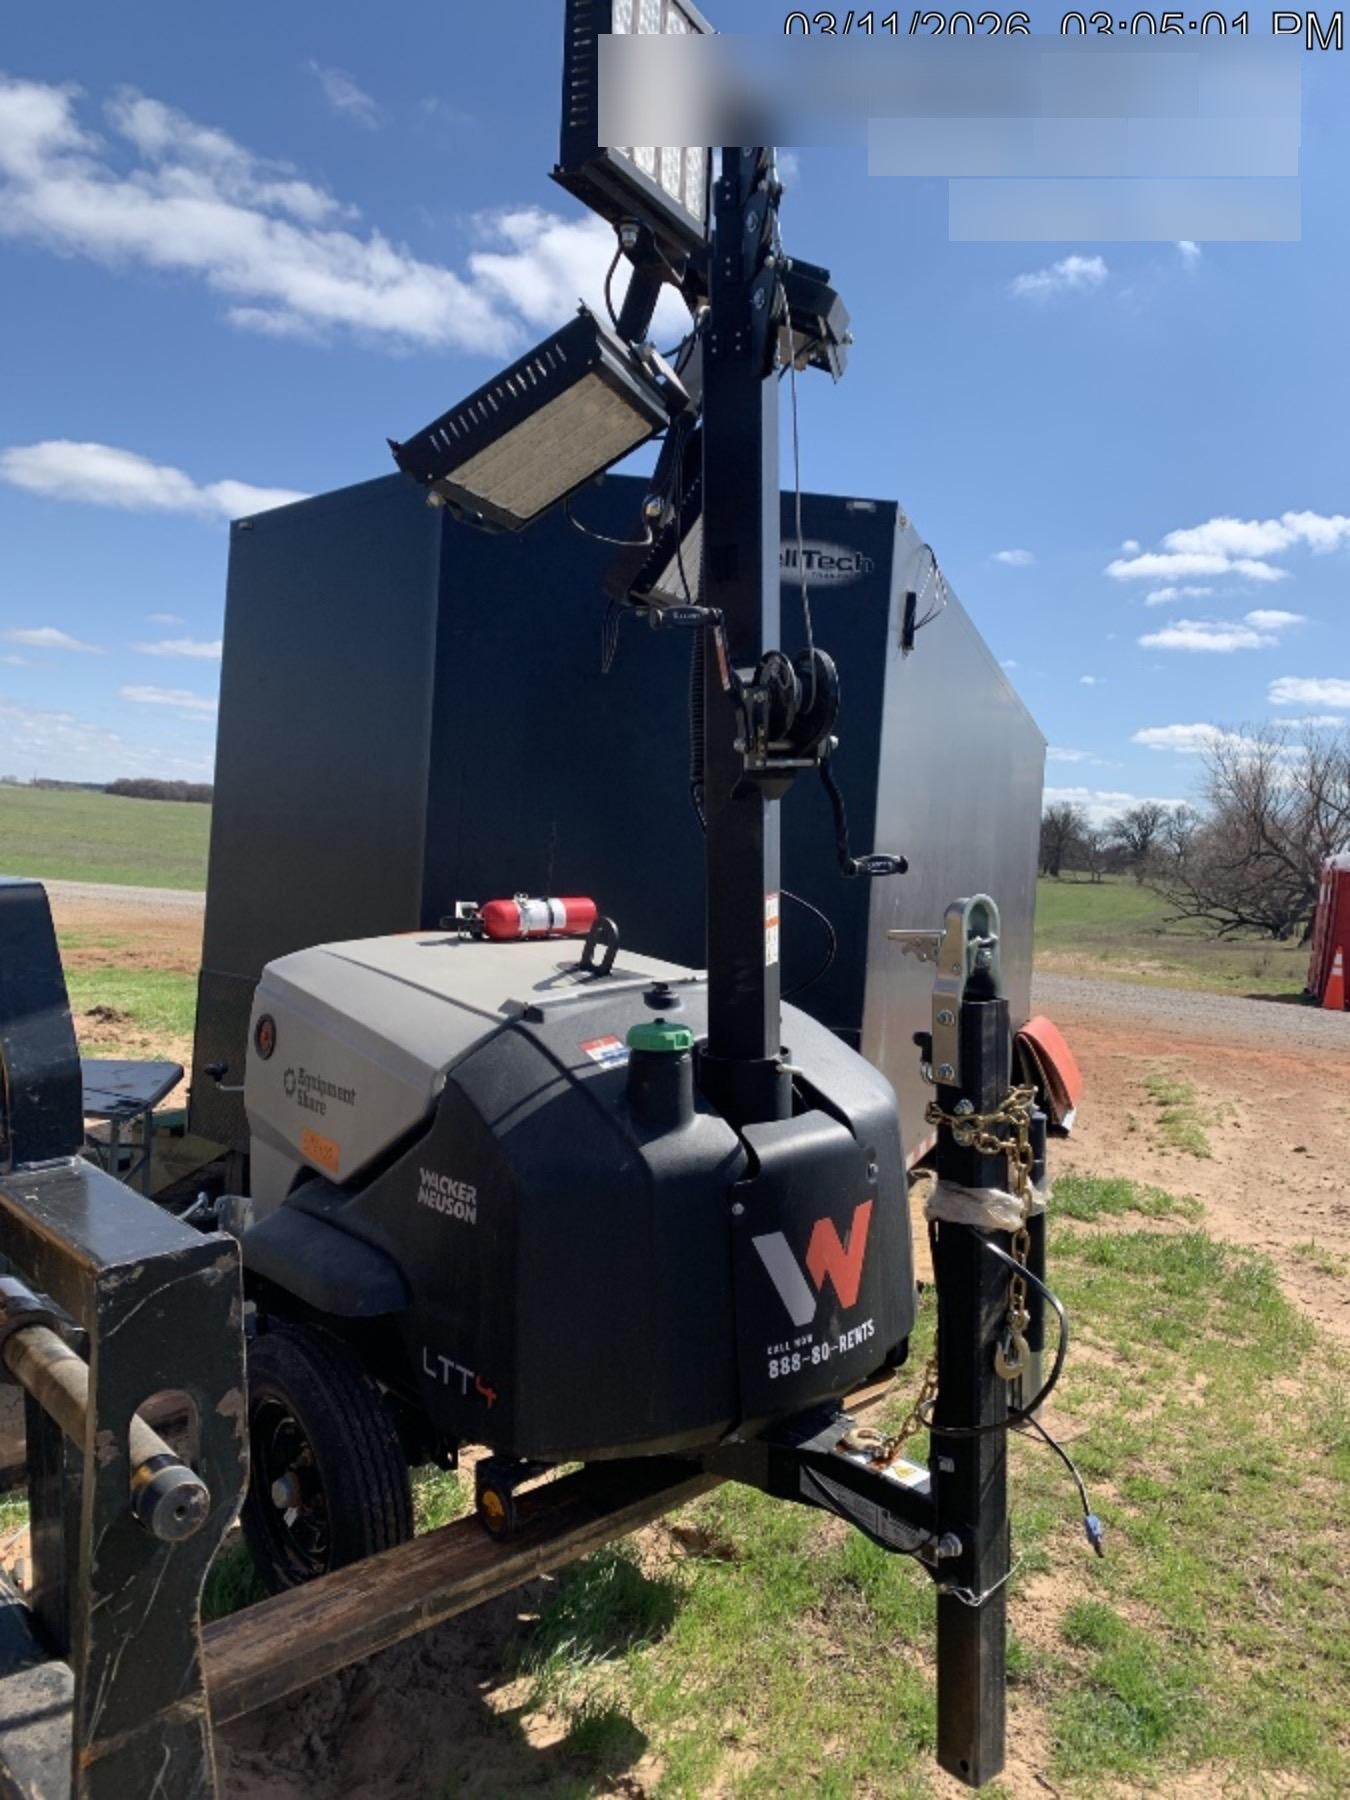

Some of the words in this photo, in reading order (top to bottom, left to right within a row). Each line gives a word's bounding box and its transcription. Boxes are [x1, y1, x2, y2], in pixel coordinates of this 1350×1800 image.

[297, 1087, 327, 1116] Share
[298, 1067, 357, 1107] Equipment
[417, 1185, 477, 1225] NEUSON
[419, 1167, 477, 1205] WACKER
[422, 1345, 497, 1409] LTT4
